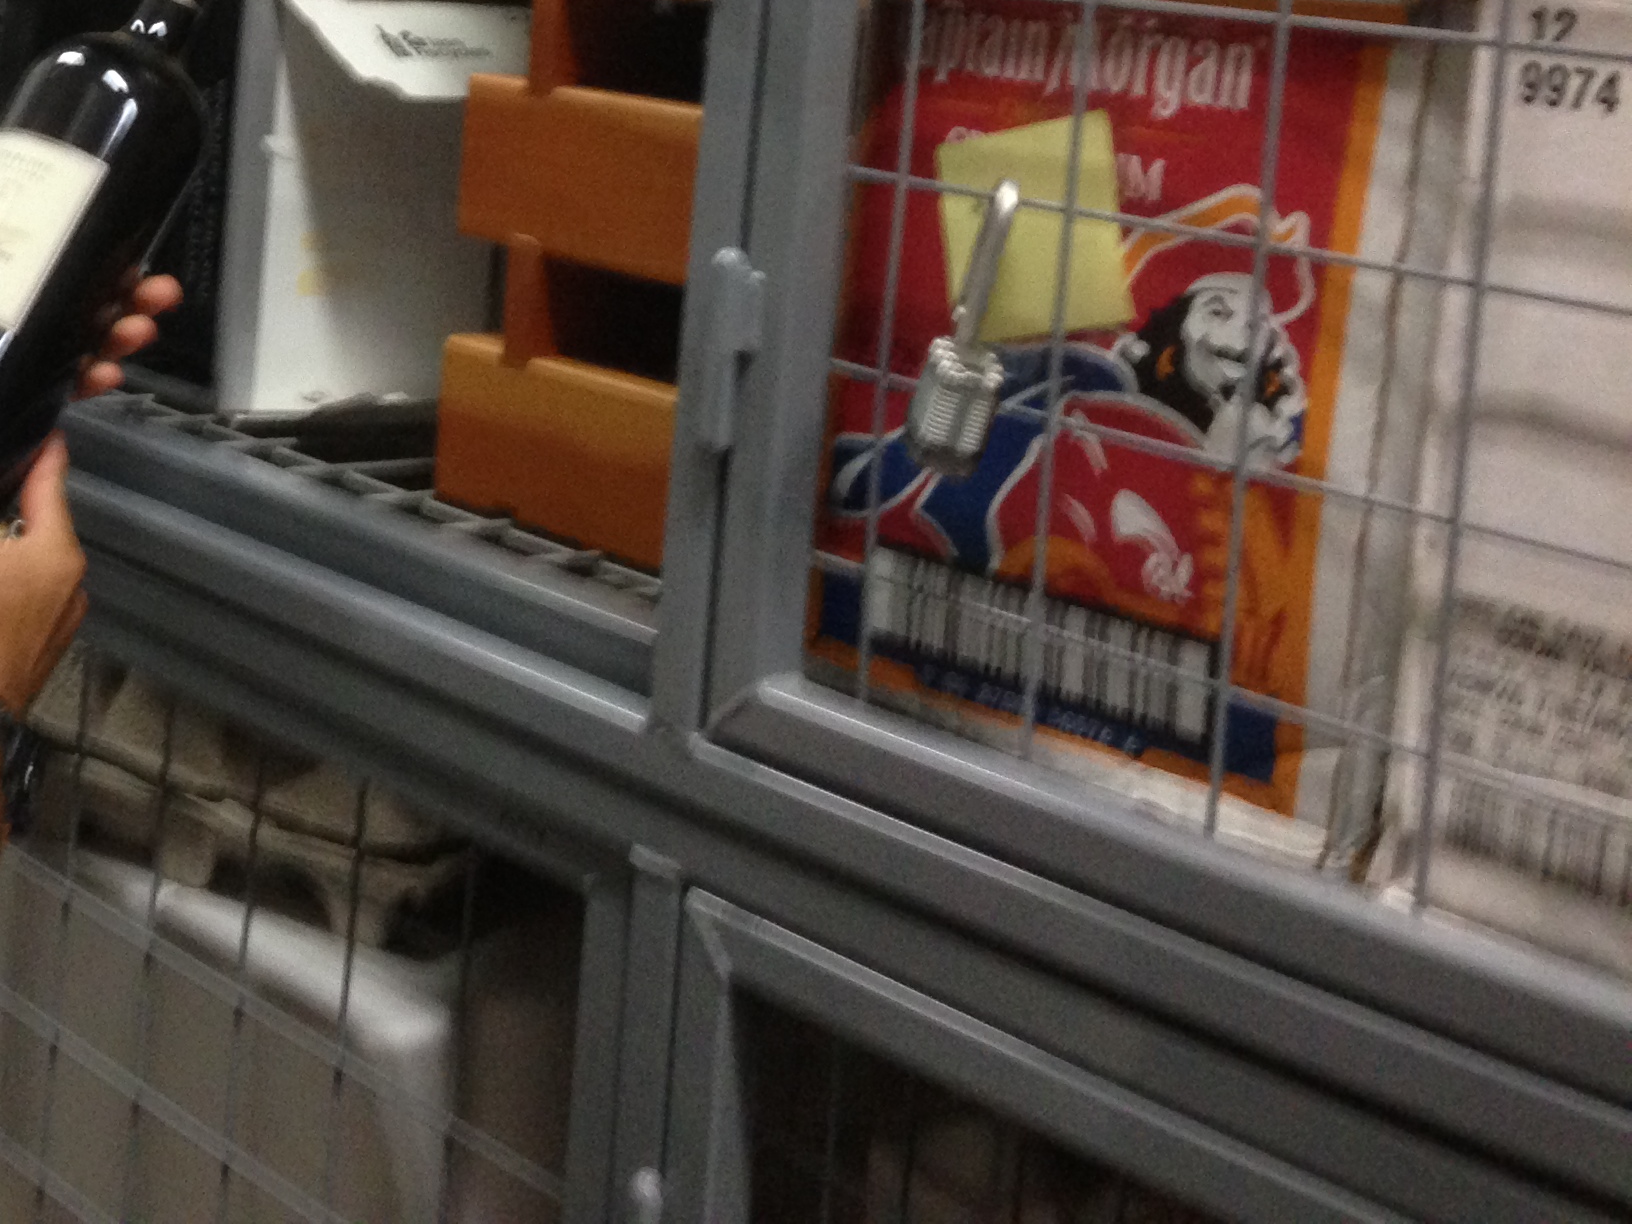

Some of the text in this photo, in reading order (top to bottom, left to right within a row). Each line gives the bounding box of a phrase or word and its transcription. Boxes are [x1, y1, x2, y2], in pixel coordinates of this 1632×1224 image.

[916, 0, 1051, 84] aptain
[1531, 6, 1578, 42] 12
[1520, 60, 1621, 114] 9974
